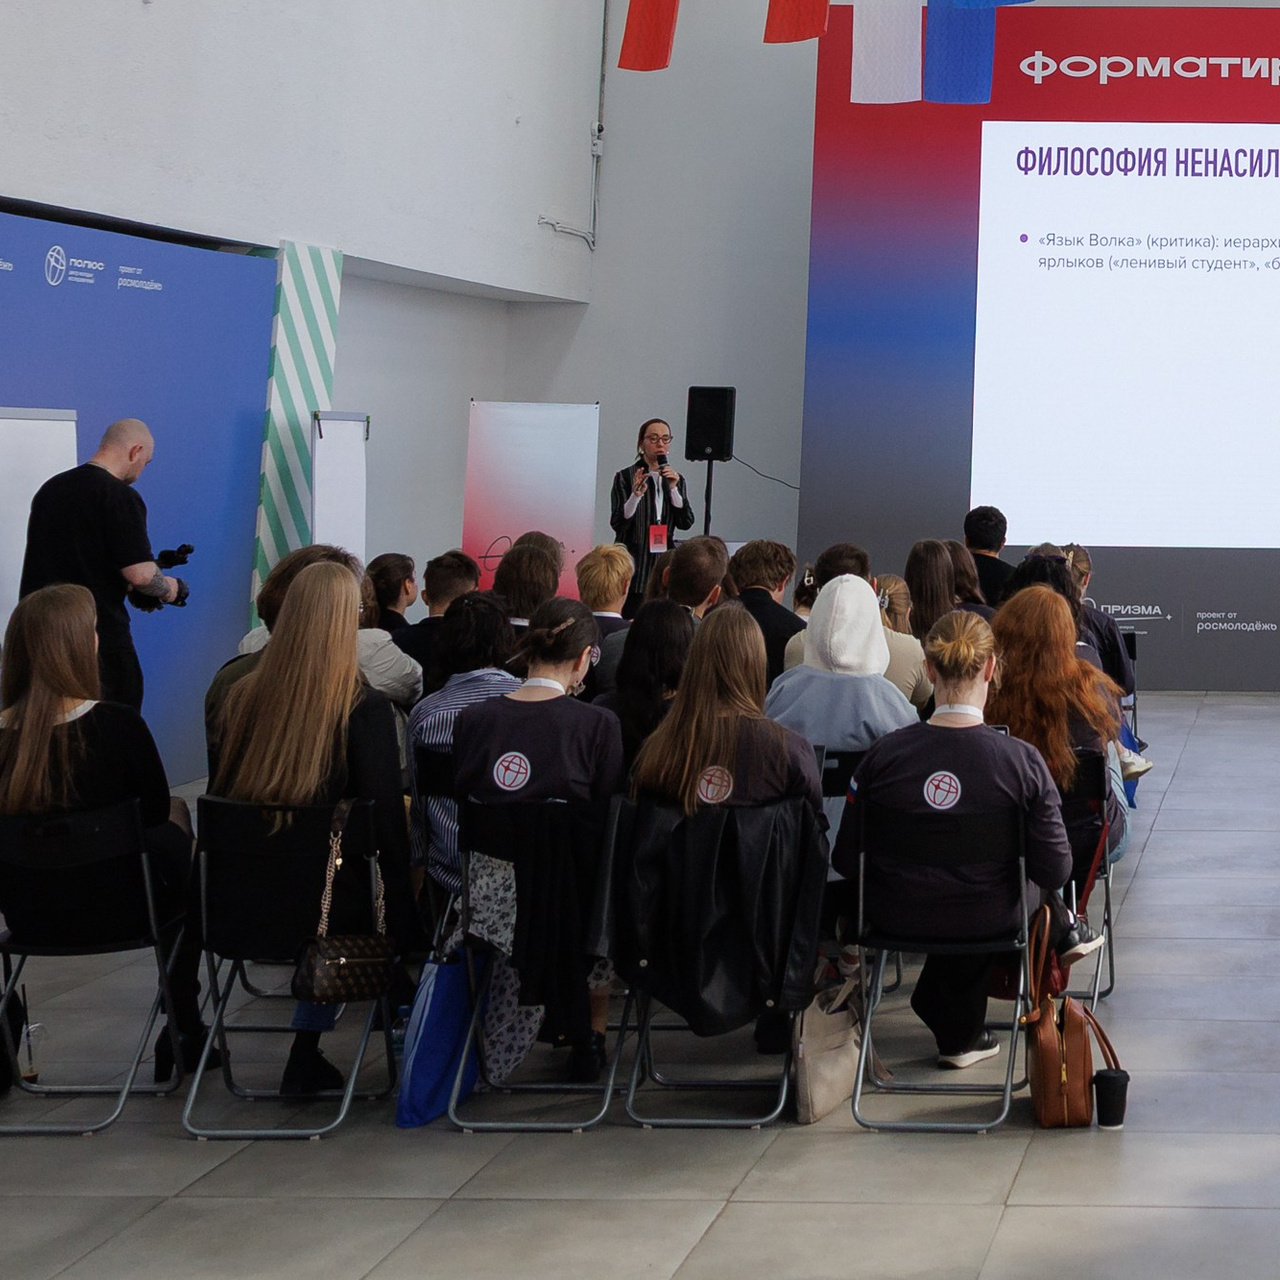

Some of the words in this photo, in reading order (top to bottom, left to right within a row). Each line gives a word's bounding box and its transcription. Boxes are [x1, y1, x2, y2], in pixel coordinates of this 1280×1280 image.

[1016, 146, 1167, 176] ФИЛОСОФИЯ
[1038, 233, 1084, 247] «Язык
[1089, 233, 1142, 247] Волка»
[1146, 234, 1219, 250] (критика):
[1038, 256, 1104, 270] ярлыков
[1108, 255, 1187, 271] («ленивый
[1191, 258, 1260, 272] студент»,
[1100, 605, 1162, 615] ПРИЗМА
[1196, 611, 1225, 620] проект
[1196, 621, 1278, 634] росмолодёжь
